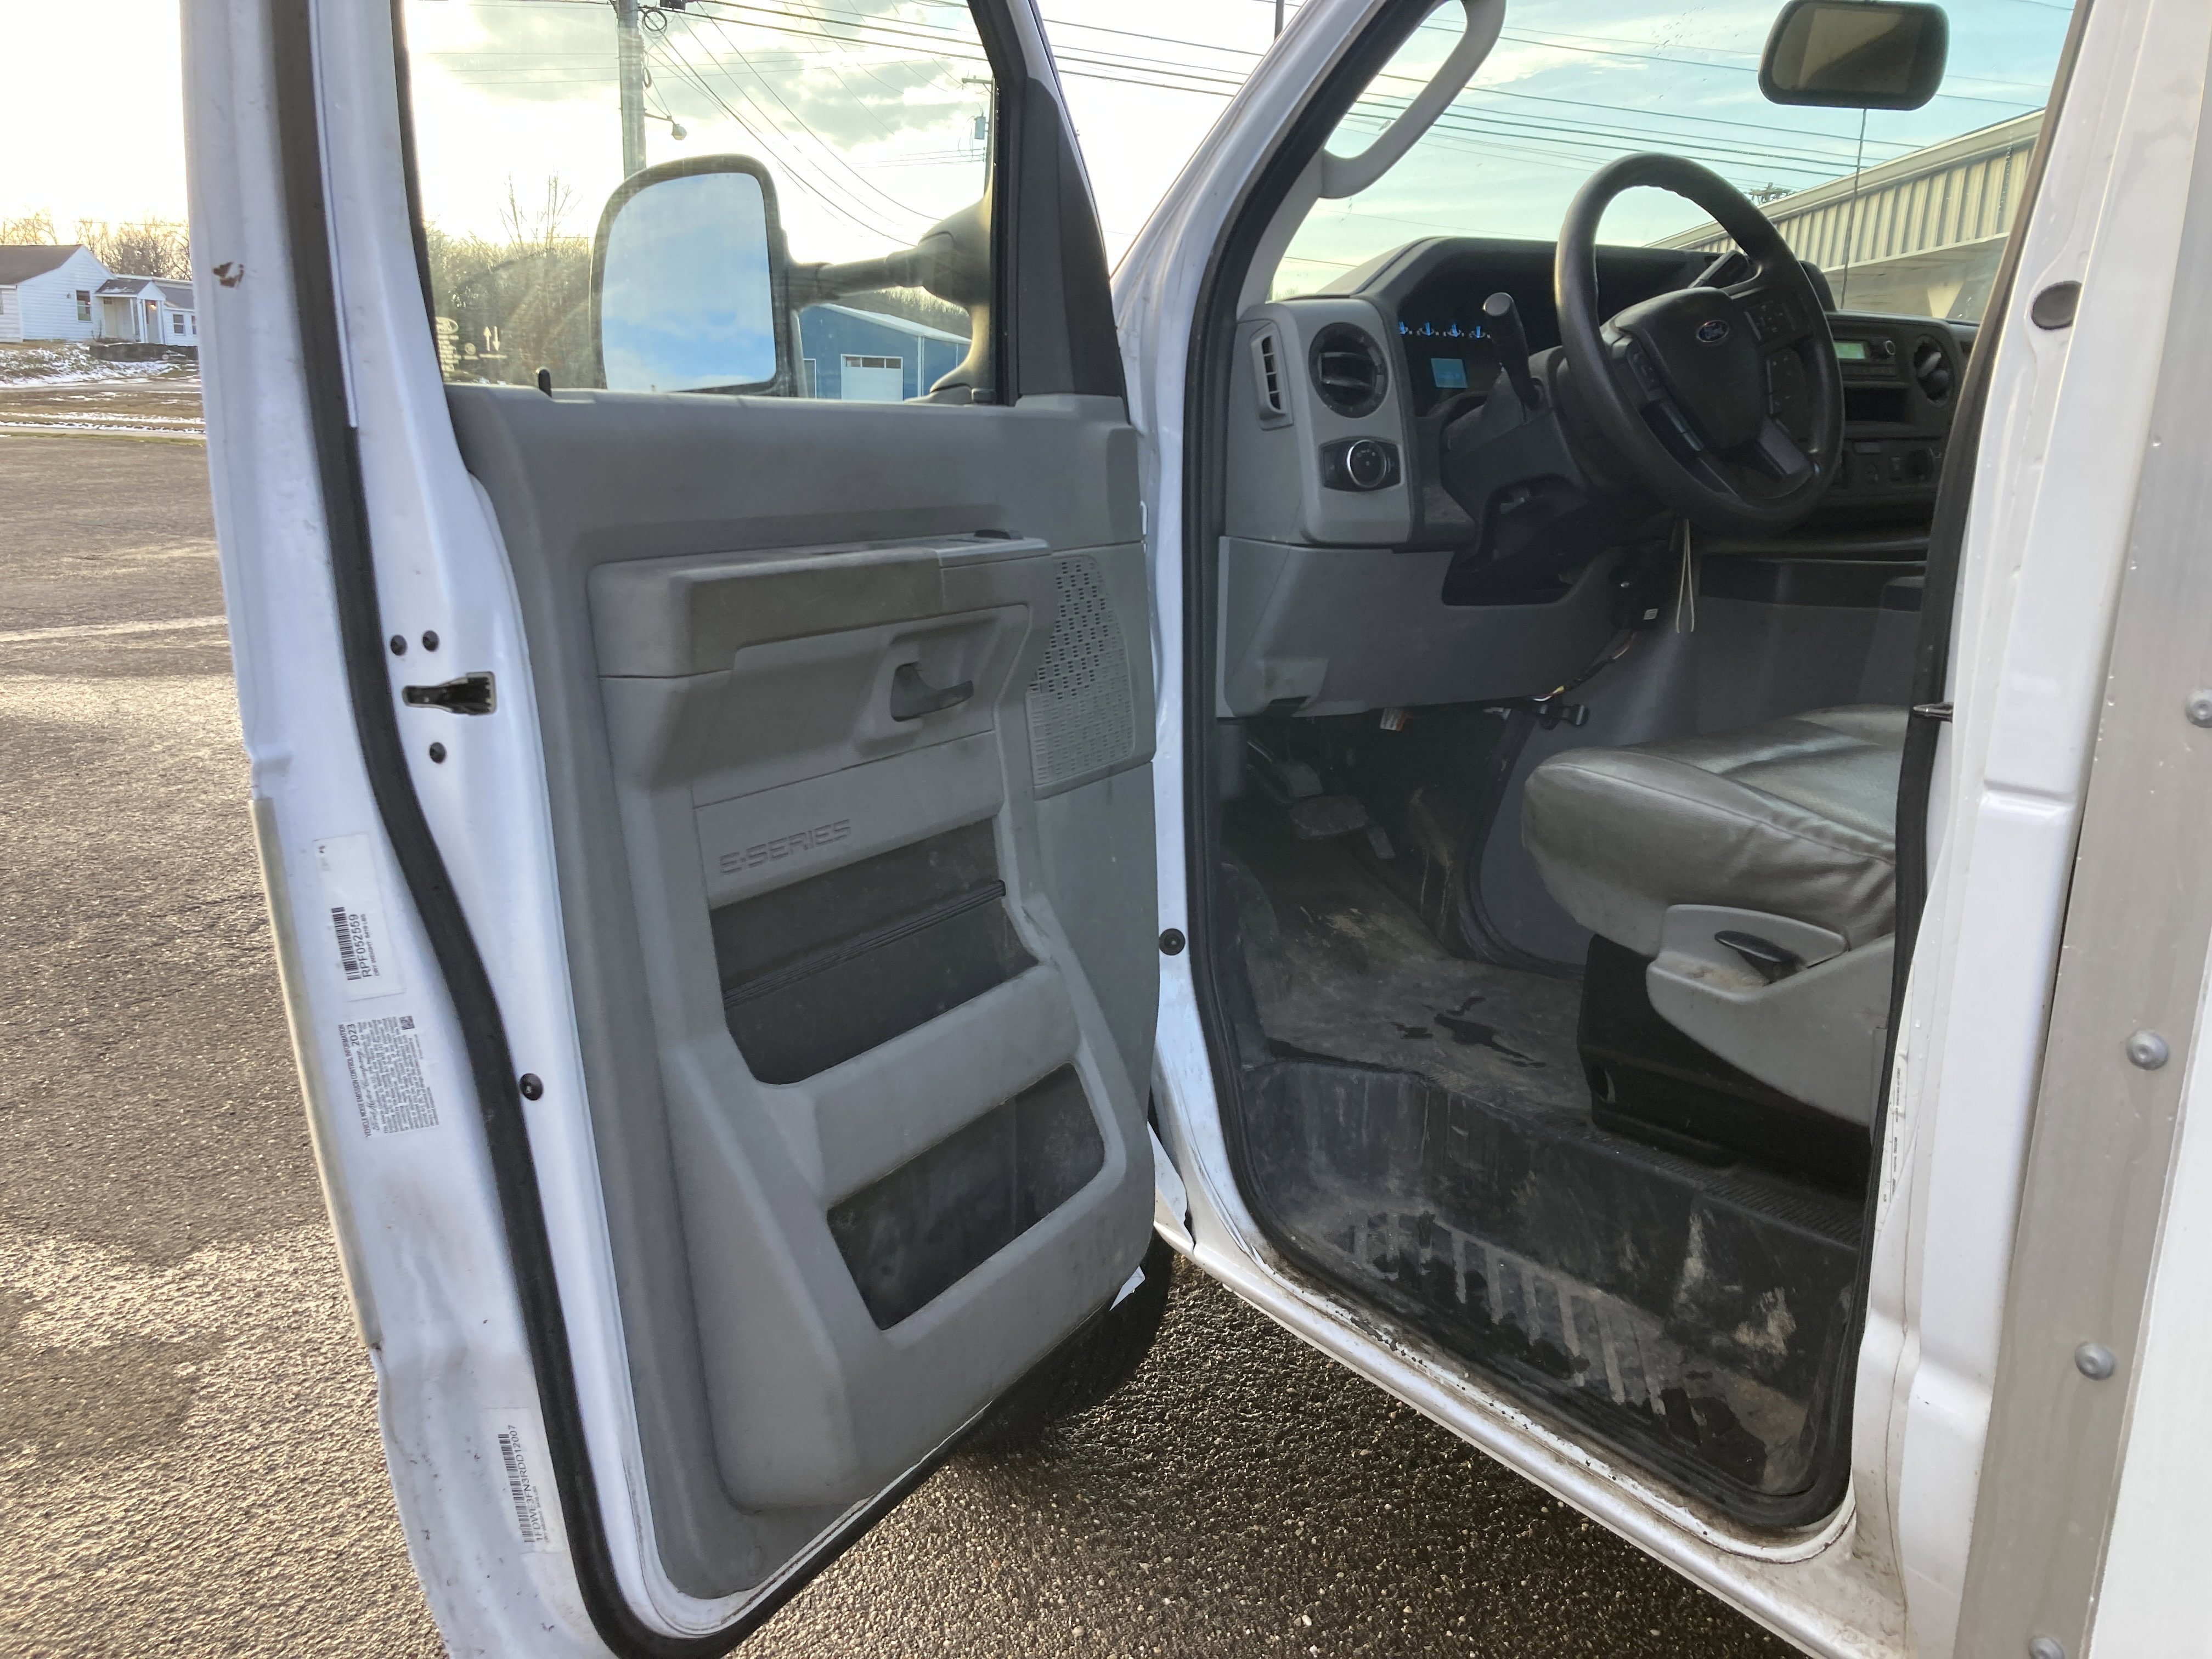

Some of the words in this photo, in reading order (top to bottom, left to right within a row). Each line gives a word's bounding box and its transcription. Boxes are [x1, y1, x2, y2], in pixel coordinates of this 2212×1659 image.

[348, 914, 371, 977] RPF052559
[338, 1024, 352, 1057] INFORMATION
[347, 1024, 359, 1046] 2023
